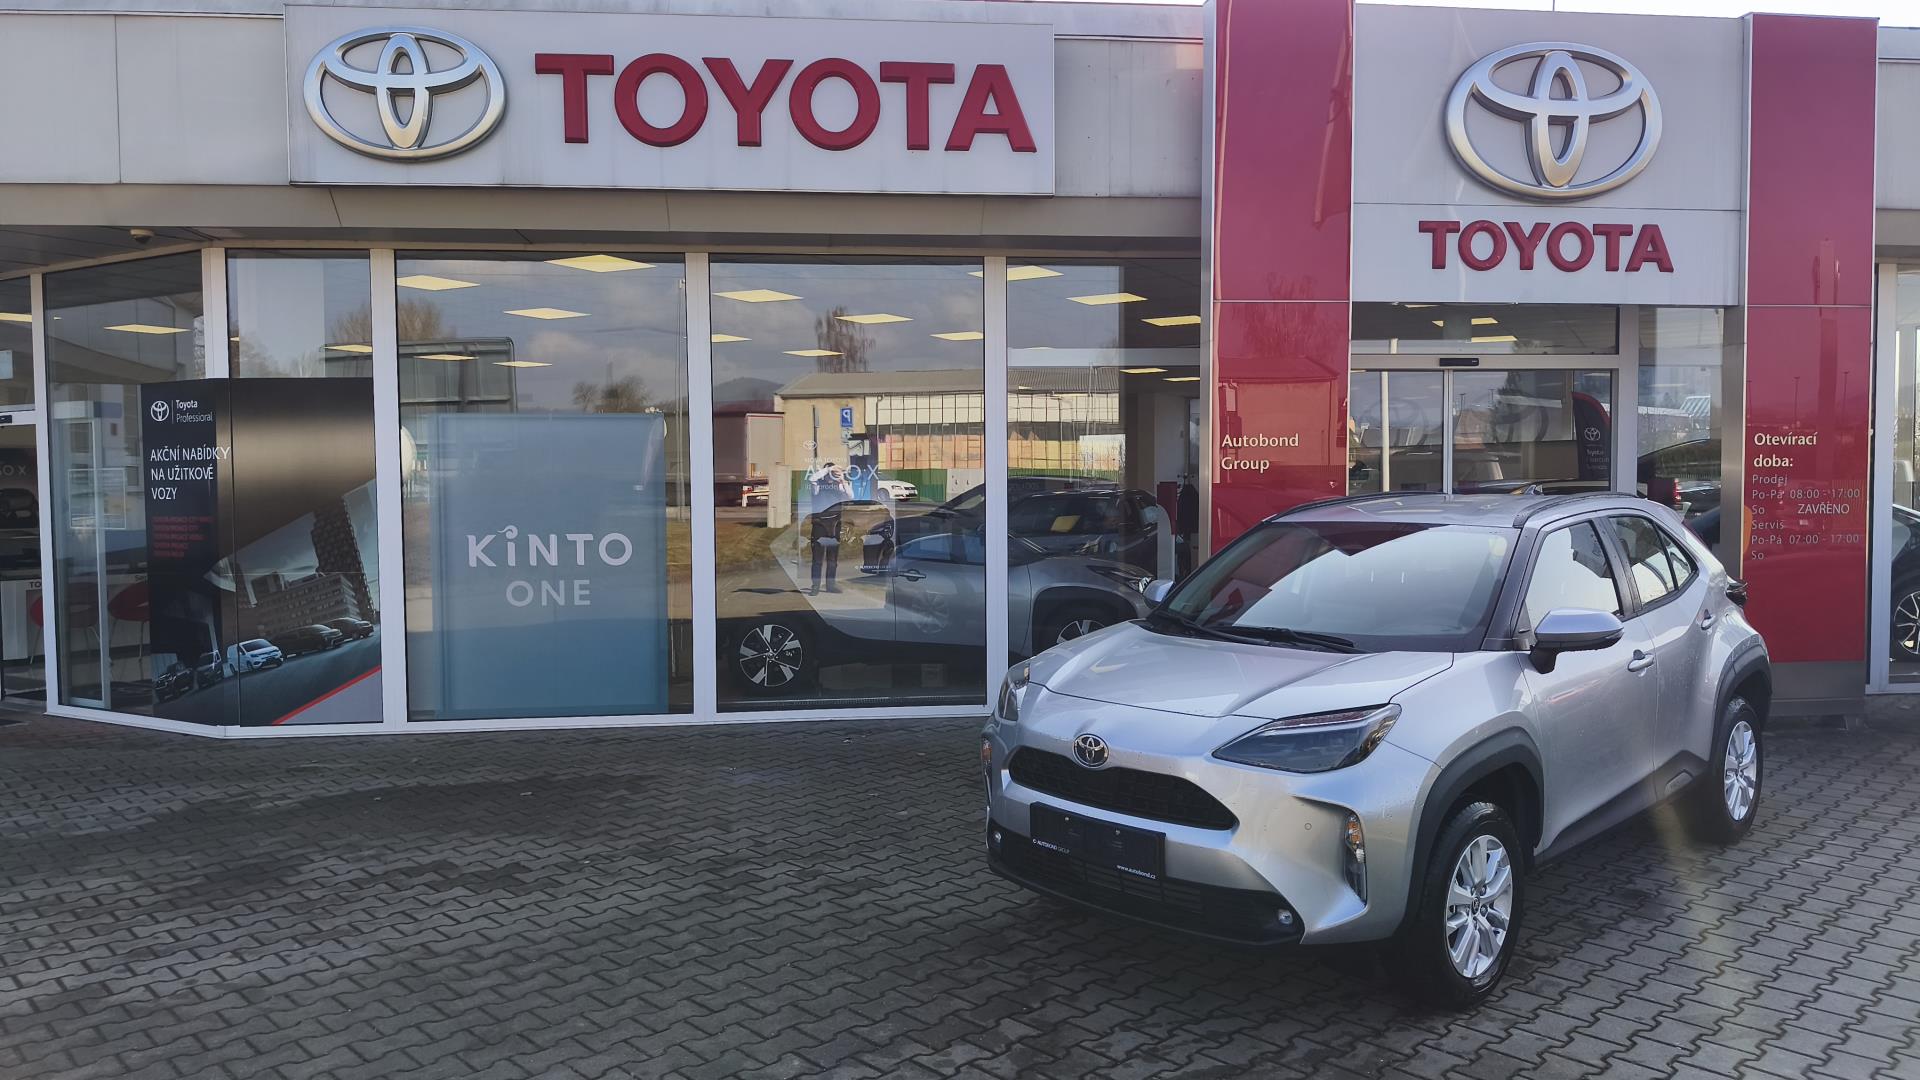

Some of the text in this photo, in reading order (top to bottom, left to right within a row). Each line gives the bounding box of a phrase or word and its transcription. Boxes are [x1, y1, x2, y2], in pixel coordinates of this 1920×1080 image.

[535, 53, 1037, 153] TOYOTA
[1418, 220, 1674, 272] TOYOTA
[175, 400, 198, 411] Toyota
[176, 411, 213, 423] Professional
[1221, 433, 1299, 447] Autobond
[1754, 431, 1818, 446] Otevírací
[150, 443, 231, 462] AKČNÍ NABÍDKY
[1221, 457, 1270, 474] Group
[1753, 453, 1794, 467] doba:
[151, 463, 214, 481] NA UŽITKOVÉ
[1752, 474, 1788, 487] Prodej
[151, 487, 177, 500] VOZY
[1790, 489, 1819, 499] 08:00
[1832, 488, 1860, 498] 17:00
[1752, 501, 1850, 515] So ZAVŘENO
[1752, 519, 1784, 530] Servis
[1789, 535, 1819, 545] 07:00
[1831, 534, 1859, 544] 17:00
[1752, 550, 1764, 560] So
[506, 579, 591, 607] ONE
